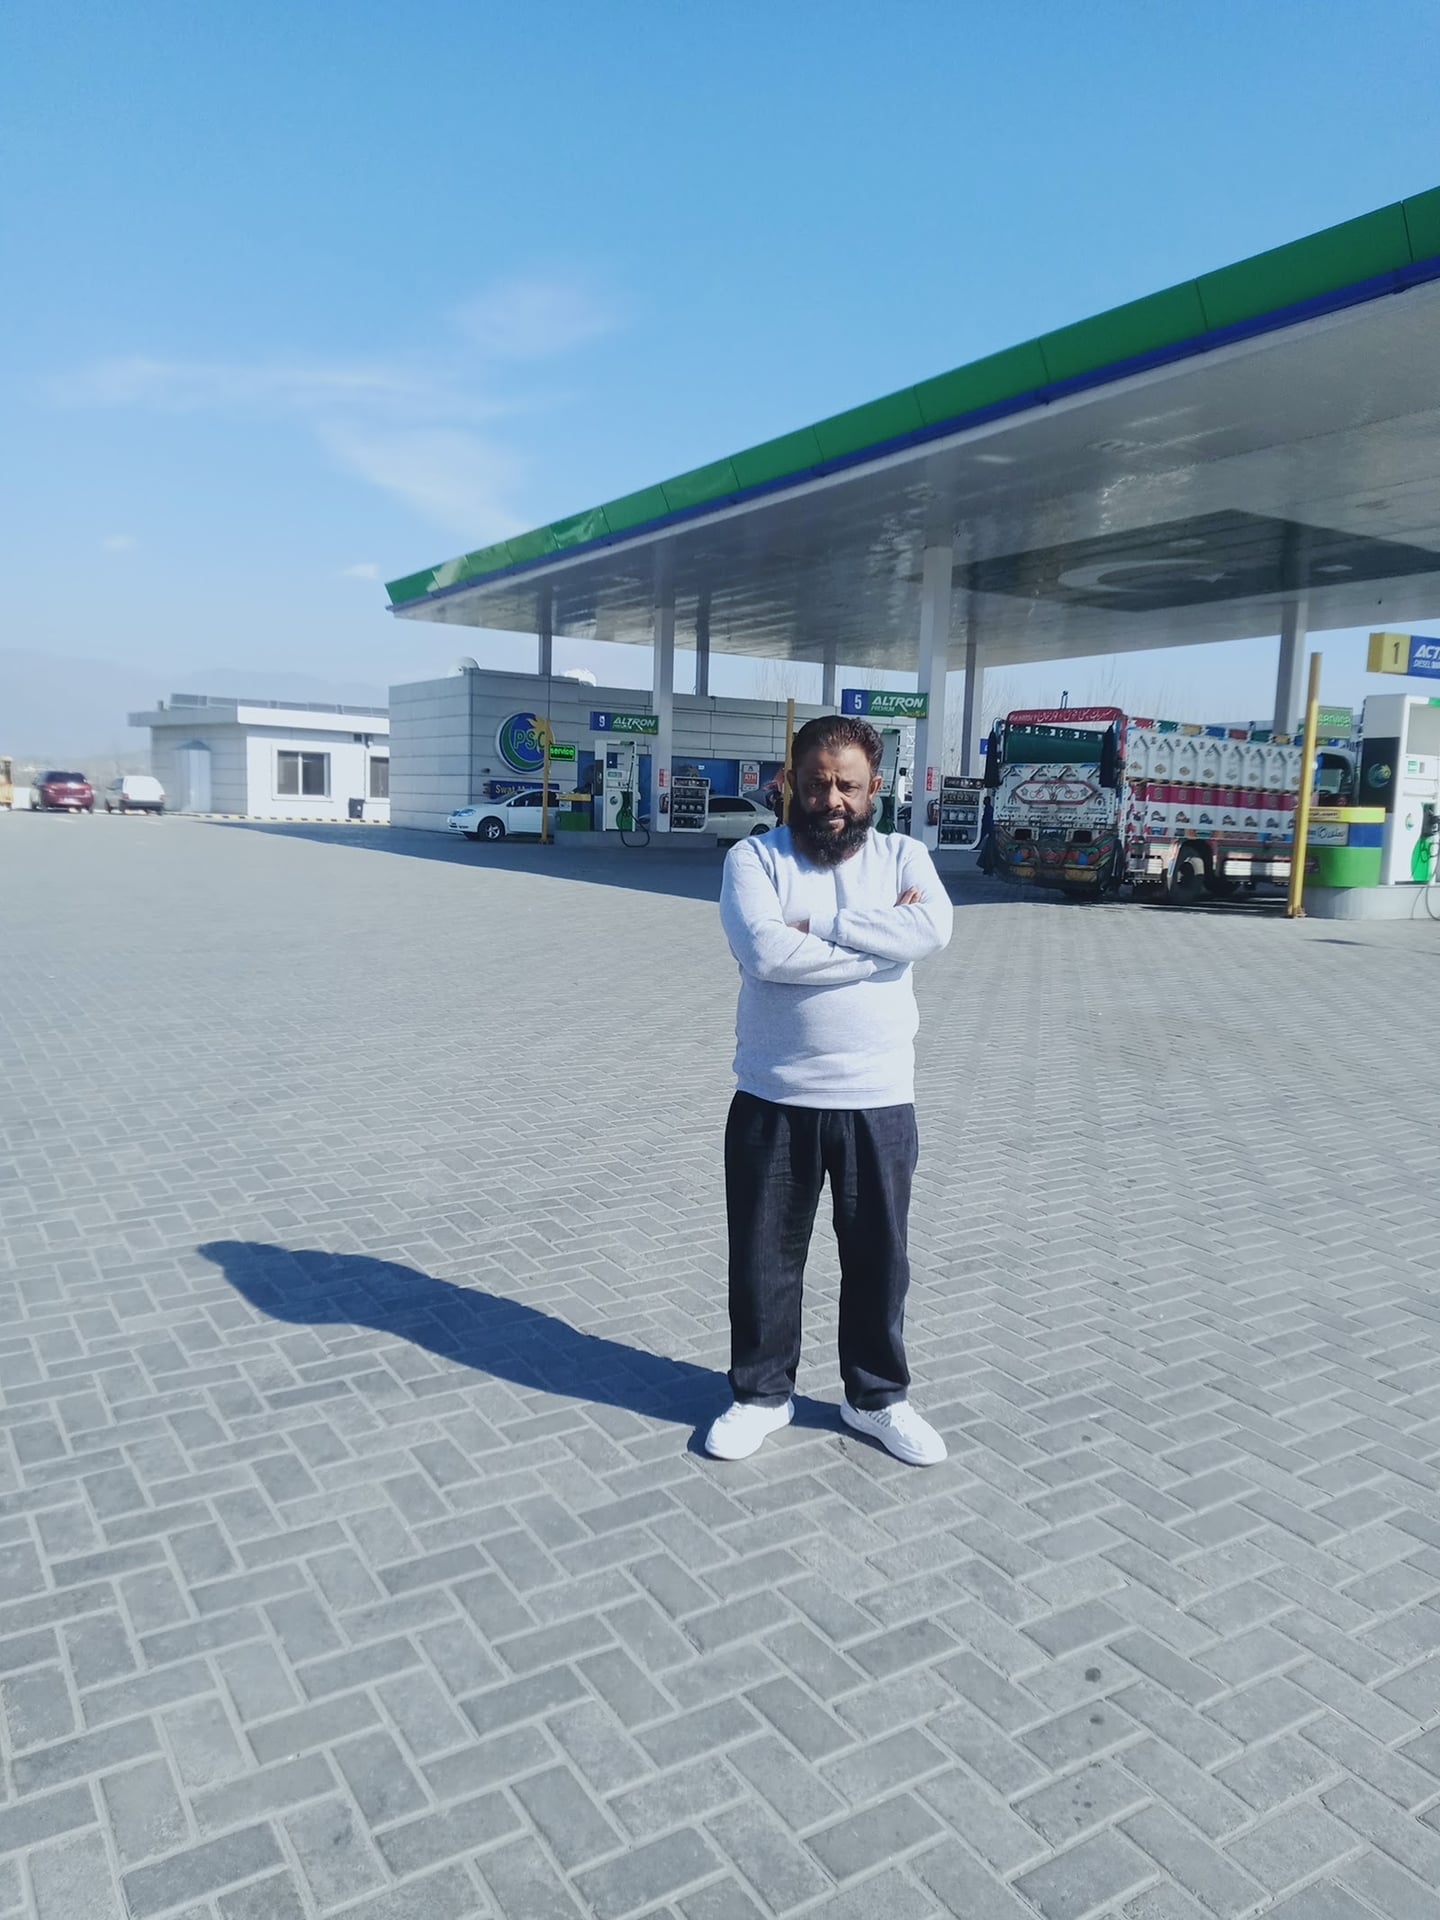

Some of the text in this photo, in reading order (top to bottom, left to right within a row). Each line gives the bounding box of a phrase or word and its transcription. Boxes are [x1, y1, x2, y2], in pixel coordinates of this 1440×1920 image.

[1393, 641, 1400, 665] 1
[1413, 644, 1440, 659] ACT
[854, 694, 862, 709] 5
[872, 696, 924, 713] ALTRON
[612, 717, 656, 731] ALTRON
